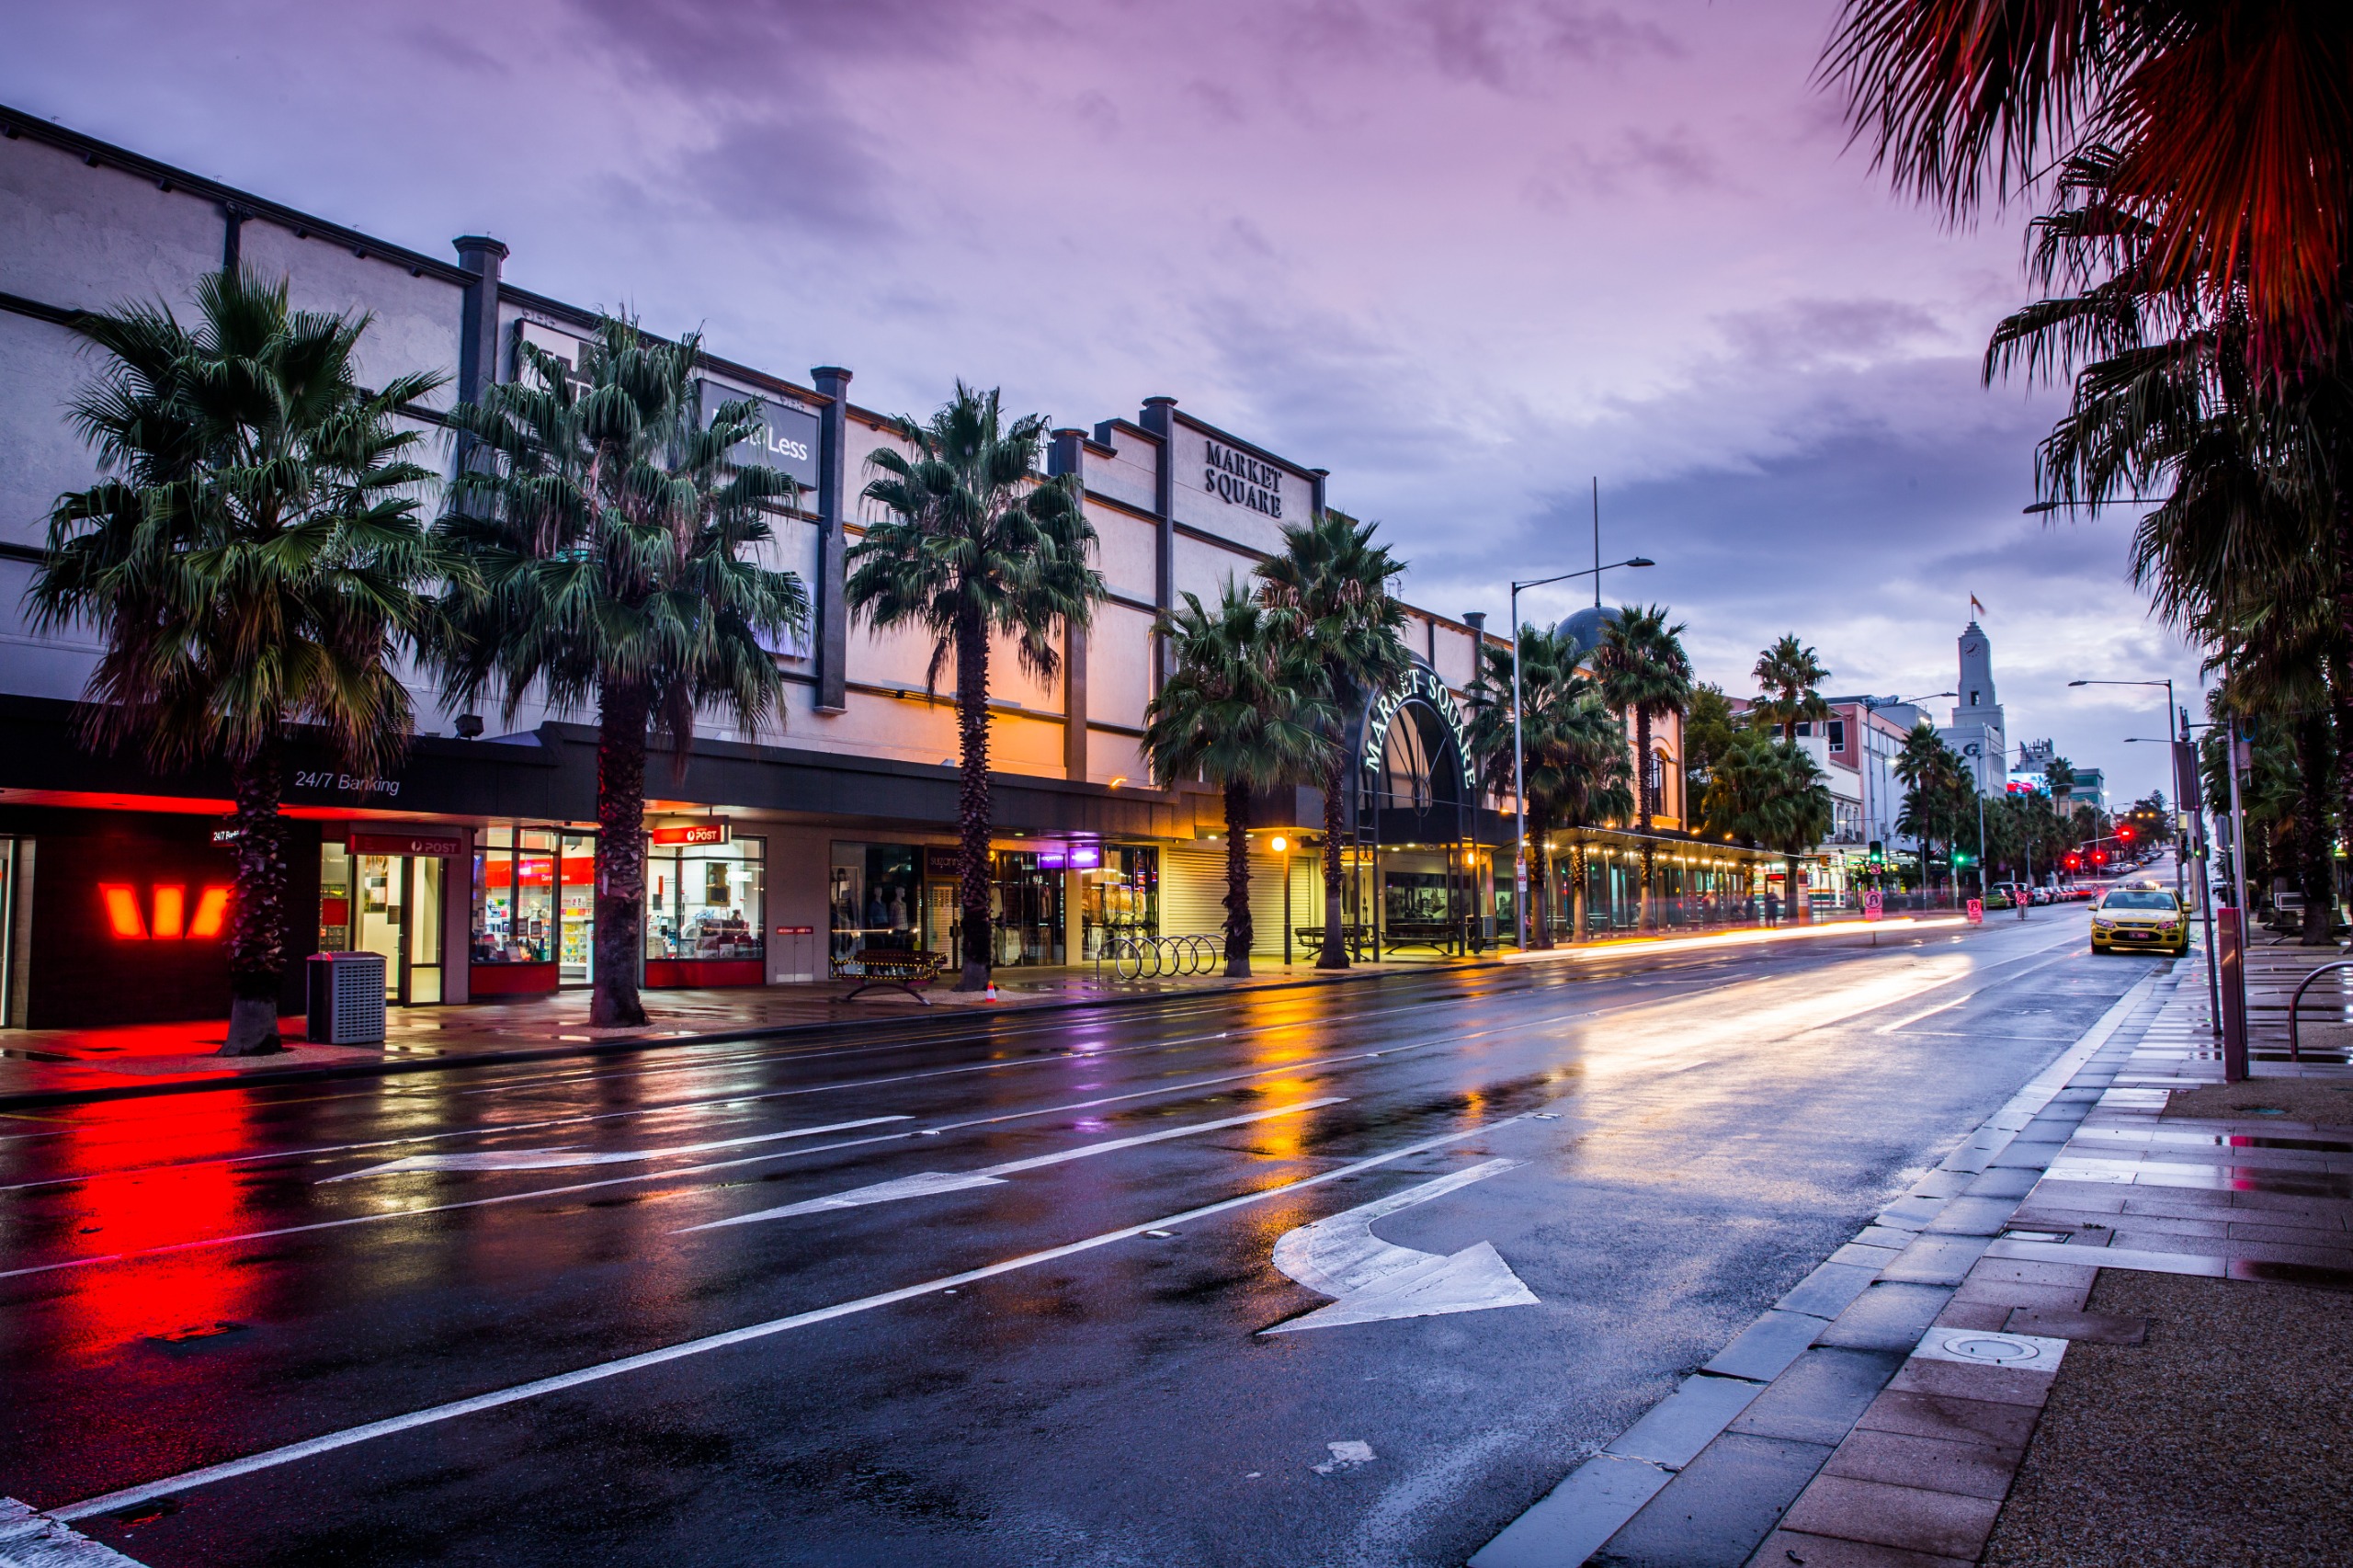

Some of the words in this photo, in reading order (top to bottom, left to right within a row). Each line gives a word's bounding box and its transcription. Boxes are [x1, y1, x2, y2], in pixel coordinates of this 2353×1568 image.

[767, 426, 808, 461] Less
[1206, 440, 1282, 493] MARKET
[1206, 468, 1282, 519] SQUARE
[1365, 669, 1420, 774] MARKET
[1428, 674, 1476, 790] SQUARE
[295, 771, 334, 788] 24/7
[337, 774, 400, 796] Banking
[213, 831, 225, 841] 24/7
[425, 842, 457, 853] POST
[696, 831, 717, 840] POST
